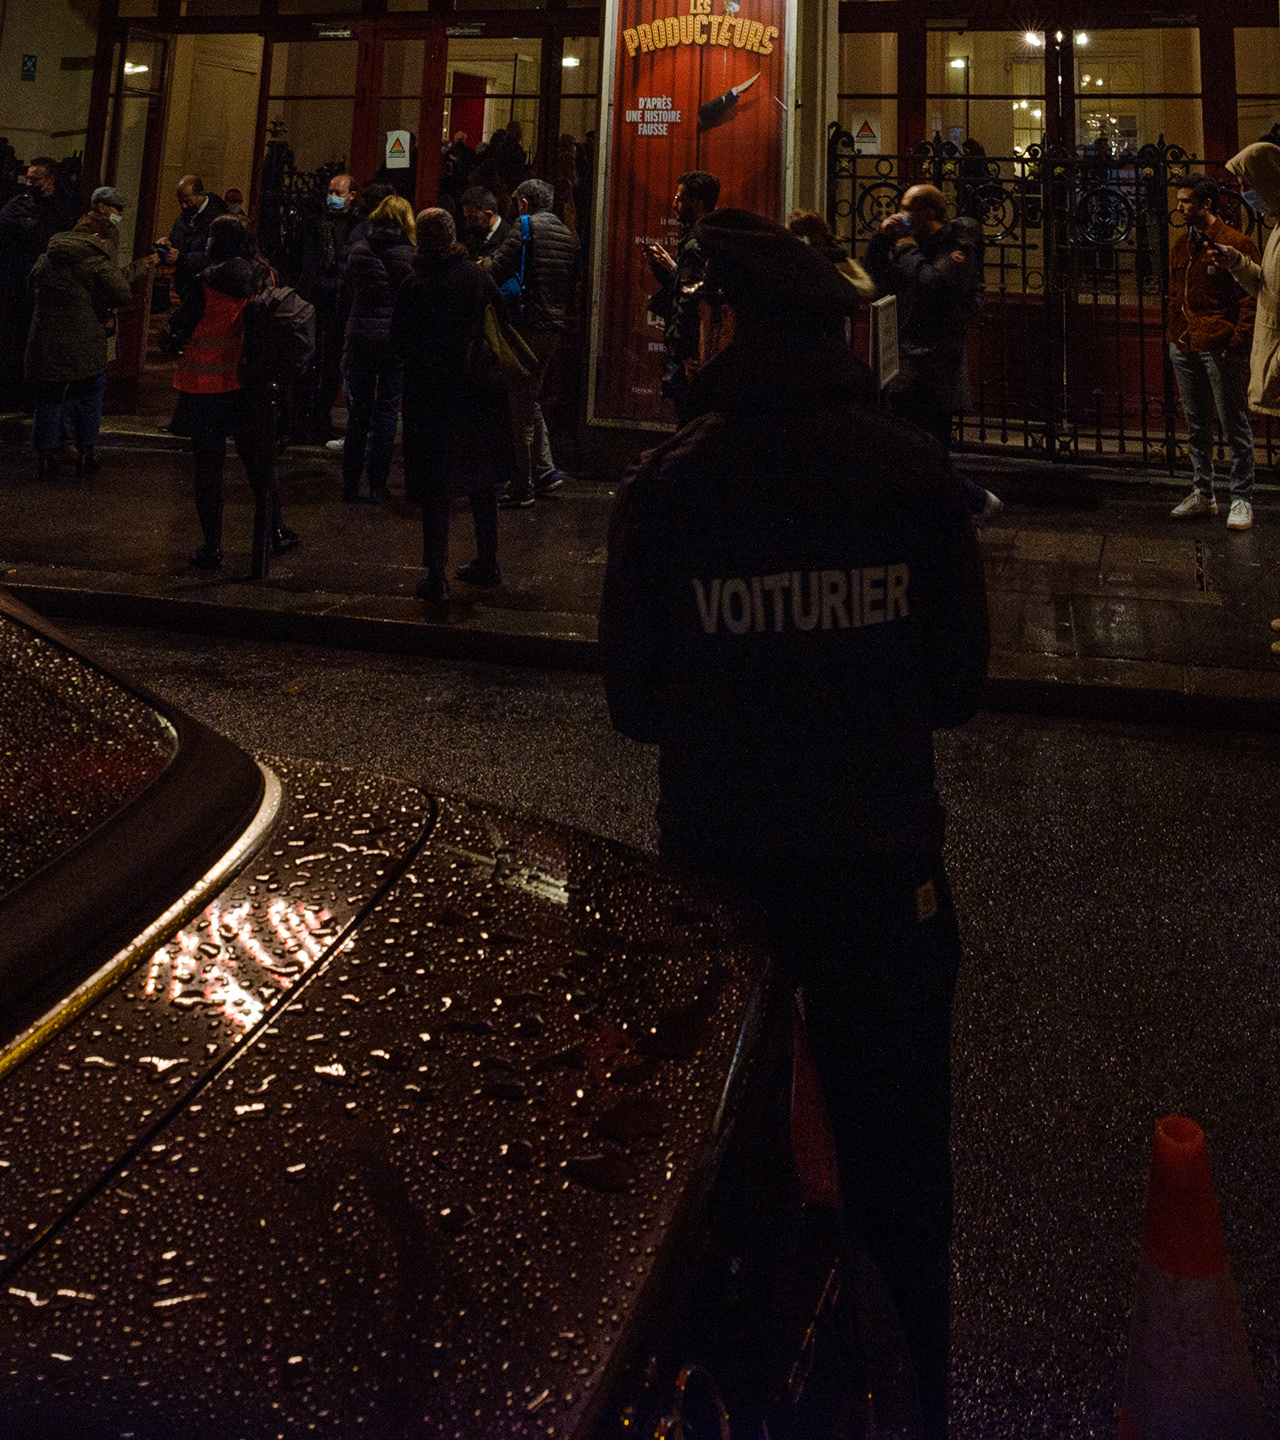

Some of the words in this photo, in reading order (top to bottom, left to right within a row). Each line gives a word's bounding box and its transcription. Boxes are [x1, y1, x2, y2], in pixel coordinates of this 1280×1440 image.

[623, 13, 779, 58] PRODUCTEURS
[625, 110, 642, 123] UNE
[644, 109, 681, 123] HISTOIRE
[638, 123, 668, 136] FAUSSE
[691, 562, 910, 635] VOITURIER
